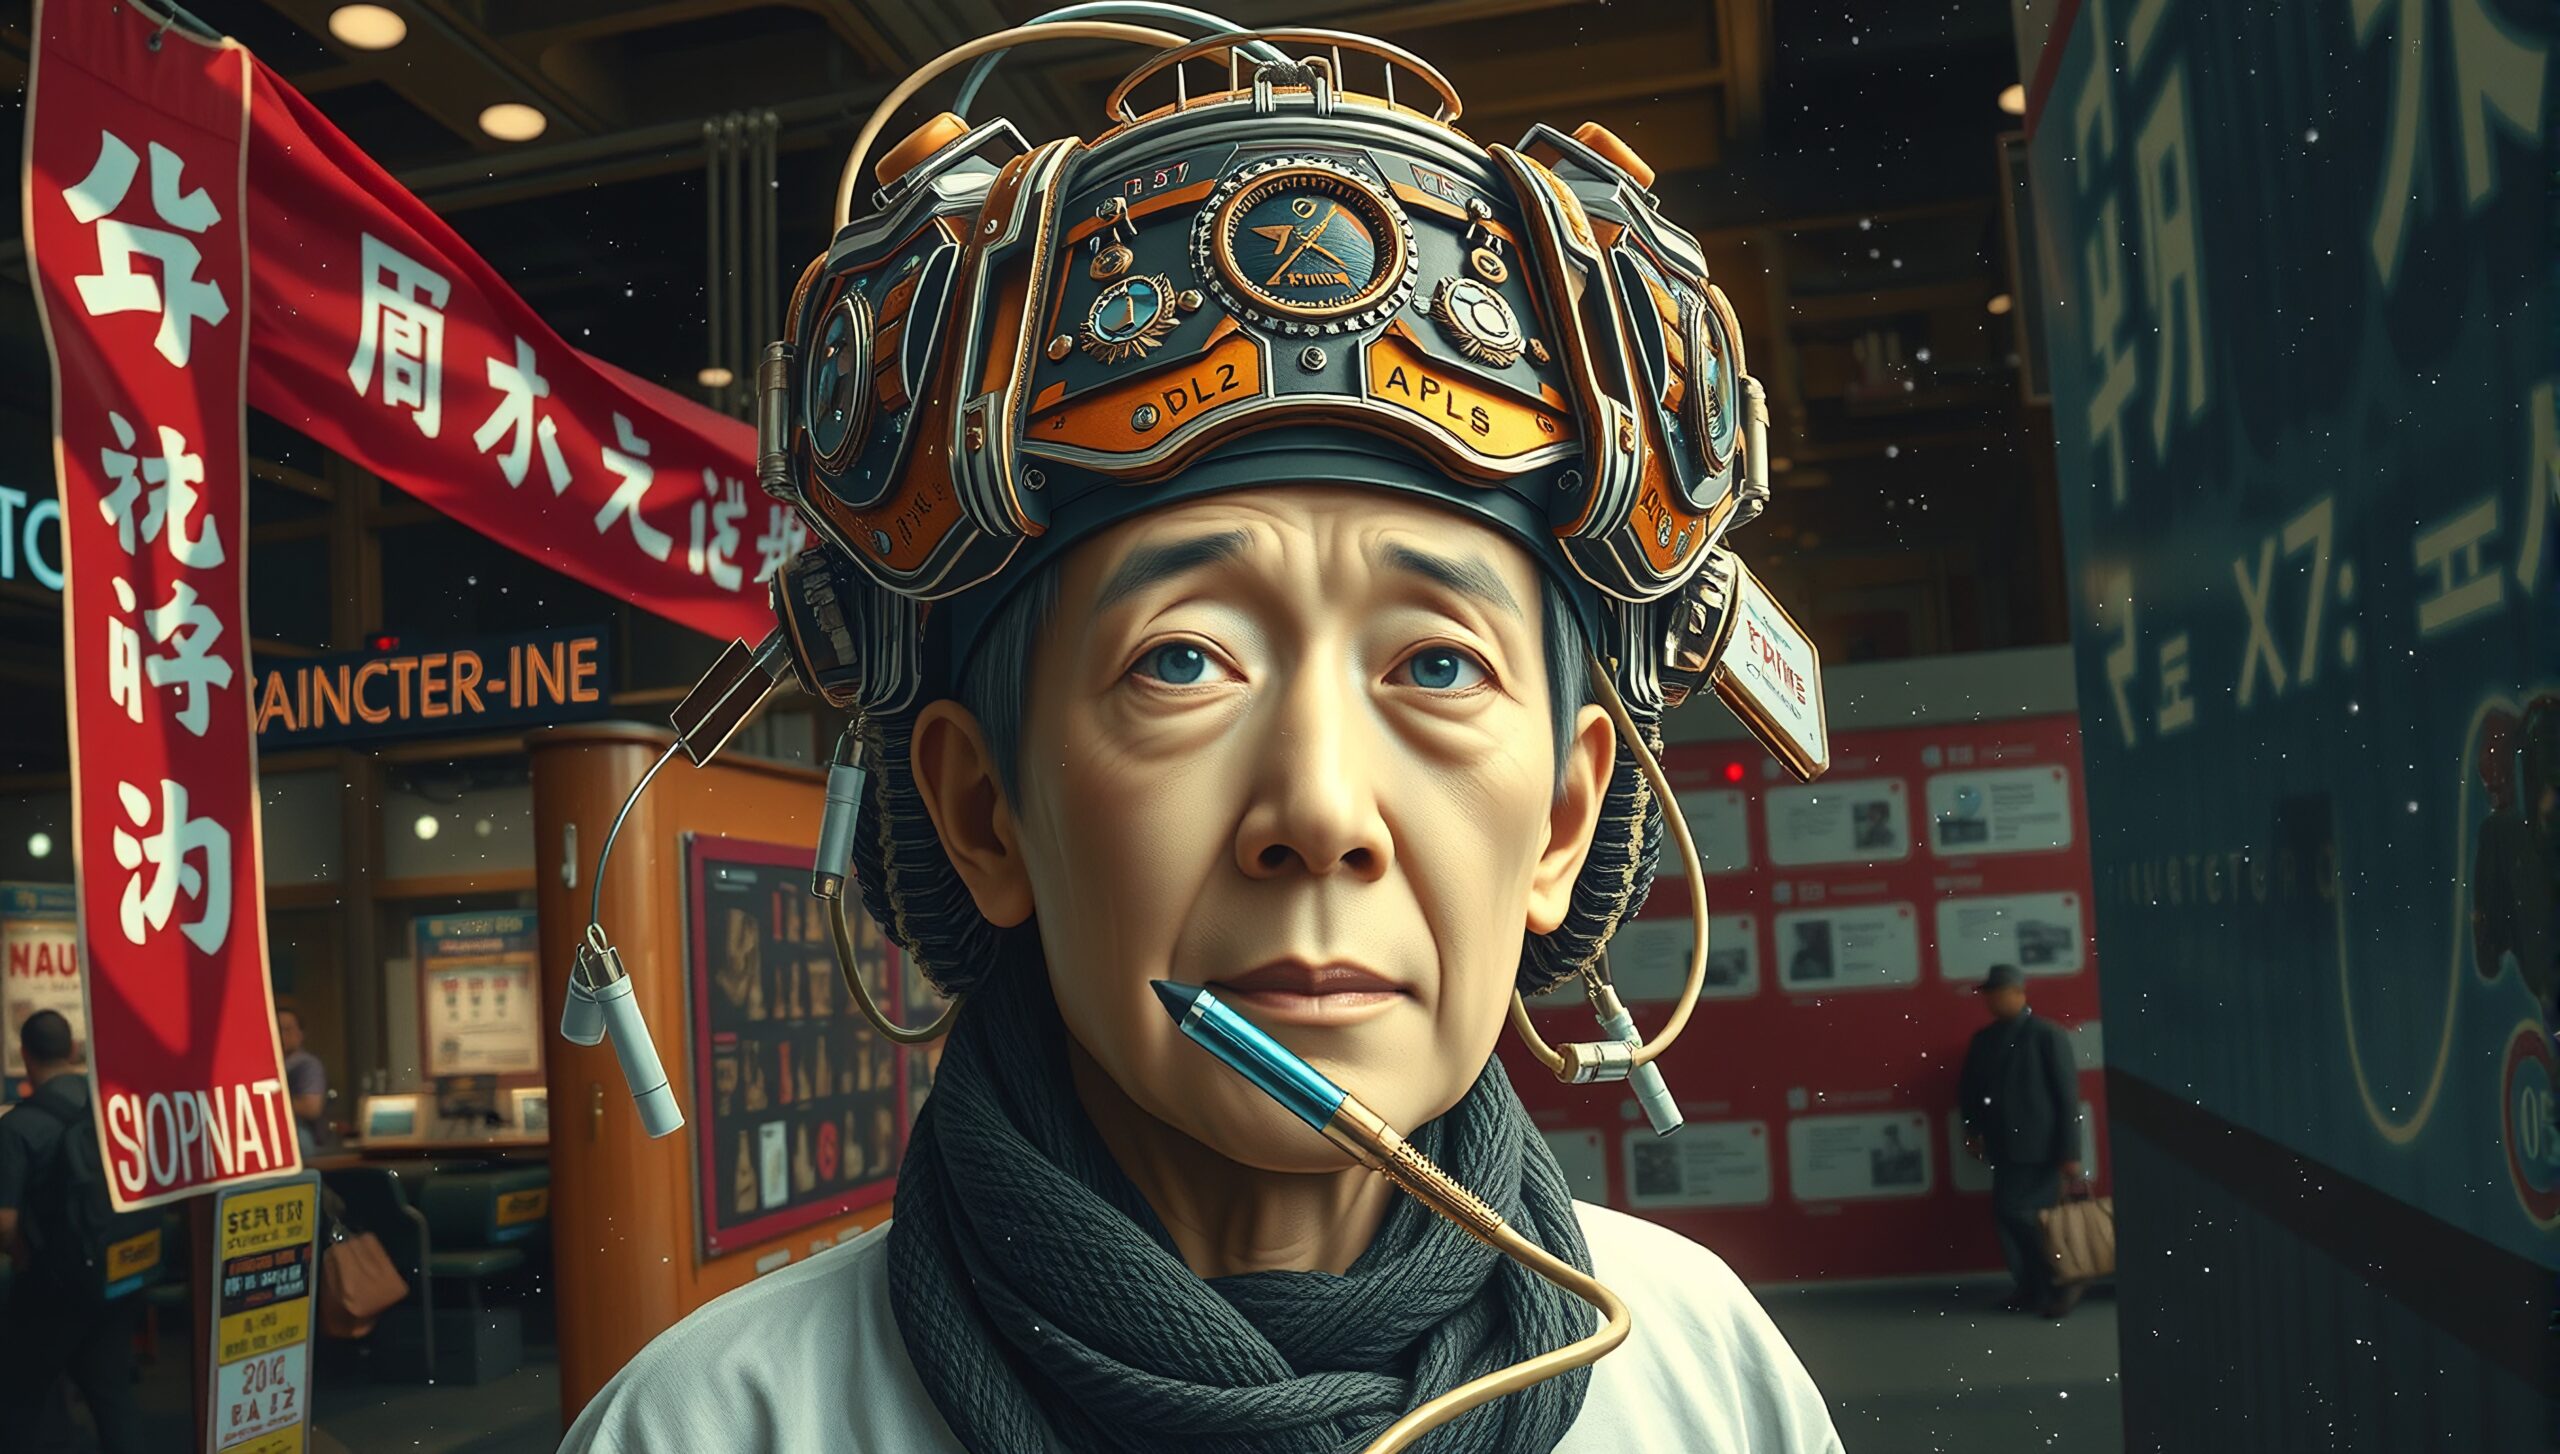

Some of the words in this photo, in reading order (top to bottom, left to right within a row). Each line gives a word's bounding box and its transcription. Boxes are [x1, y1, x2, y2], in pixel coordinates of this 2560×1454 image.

[1160, 363, 1240, 416] DL2
[1385, 364, 1490, 437] APLS
[252, 637, 599, 734] AINCTER-INE
